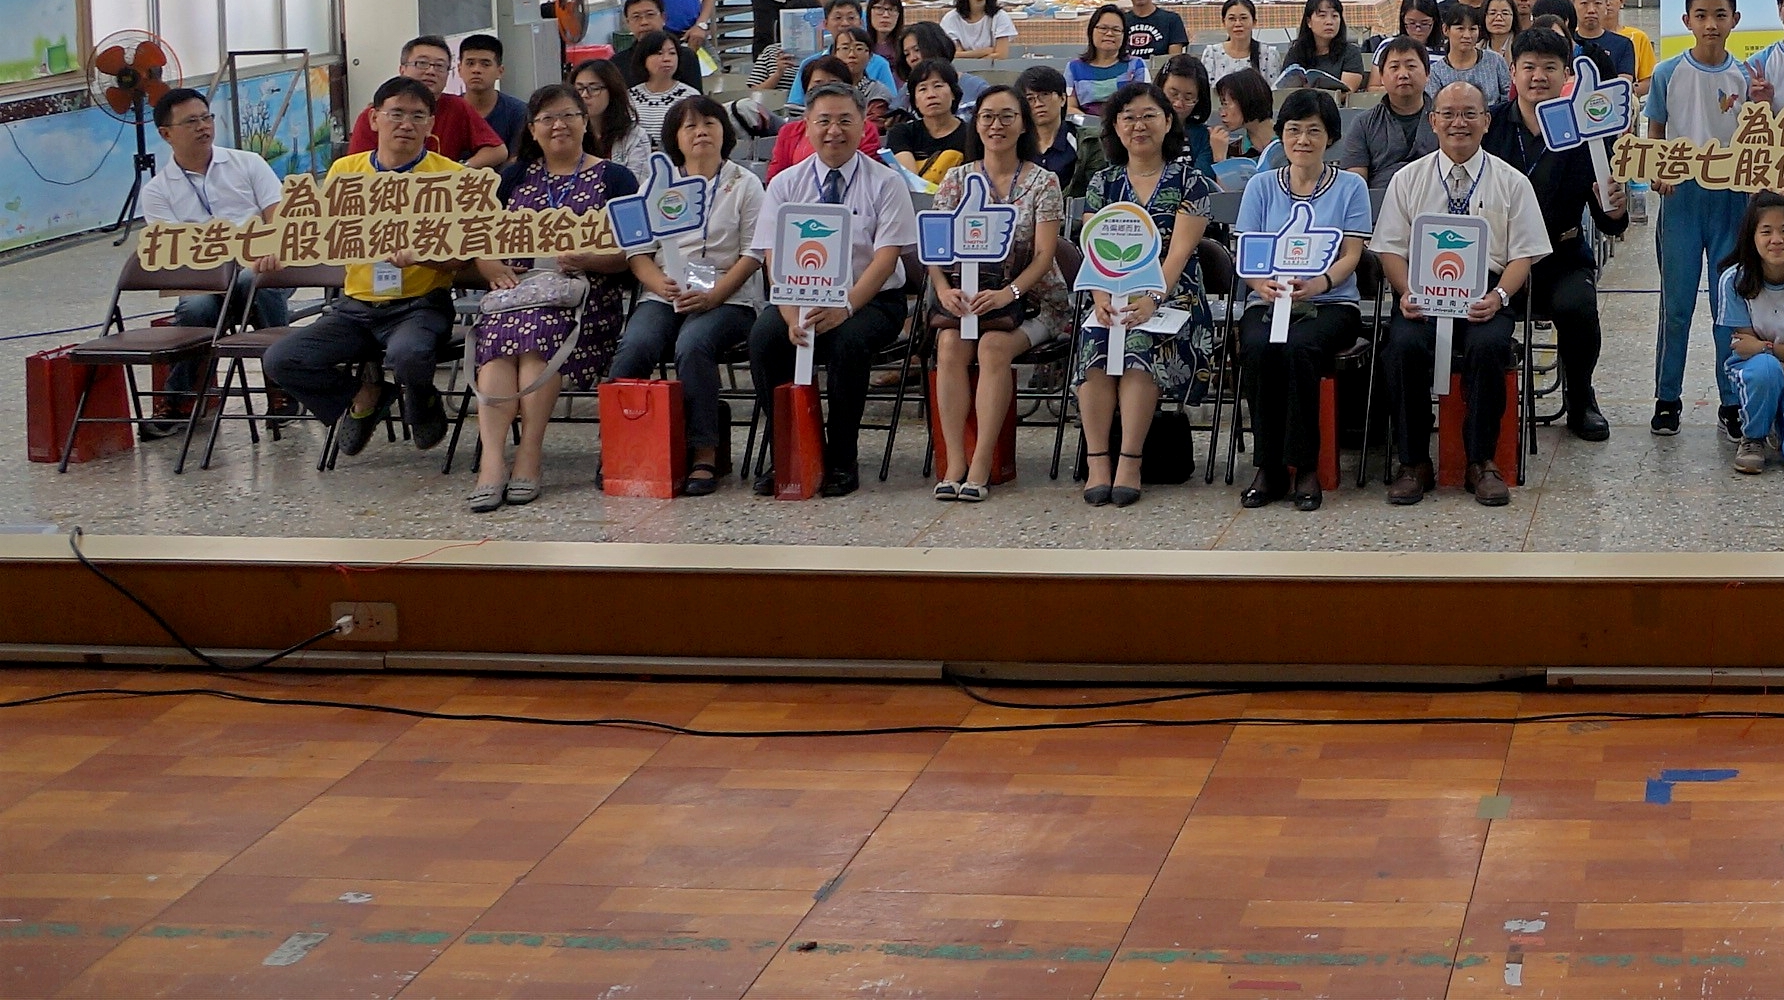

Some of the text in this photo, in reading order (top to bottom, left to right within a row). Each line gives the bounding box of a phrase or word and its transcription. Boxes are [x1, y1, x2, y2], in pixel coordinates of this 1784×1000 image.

[280, 172, 497, 218] 為偏鄉而教
[143, 216, 615, 268] 打造七股偏鄉教育補給站
[788, 275, 832, 287] NUTN
[1425, 286, 1469, 298] NUTN
[1410, 297, 1478, 308] 國立臺南大
